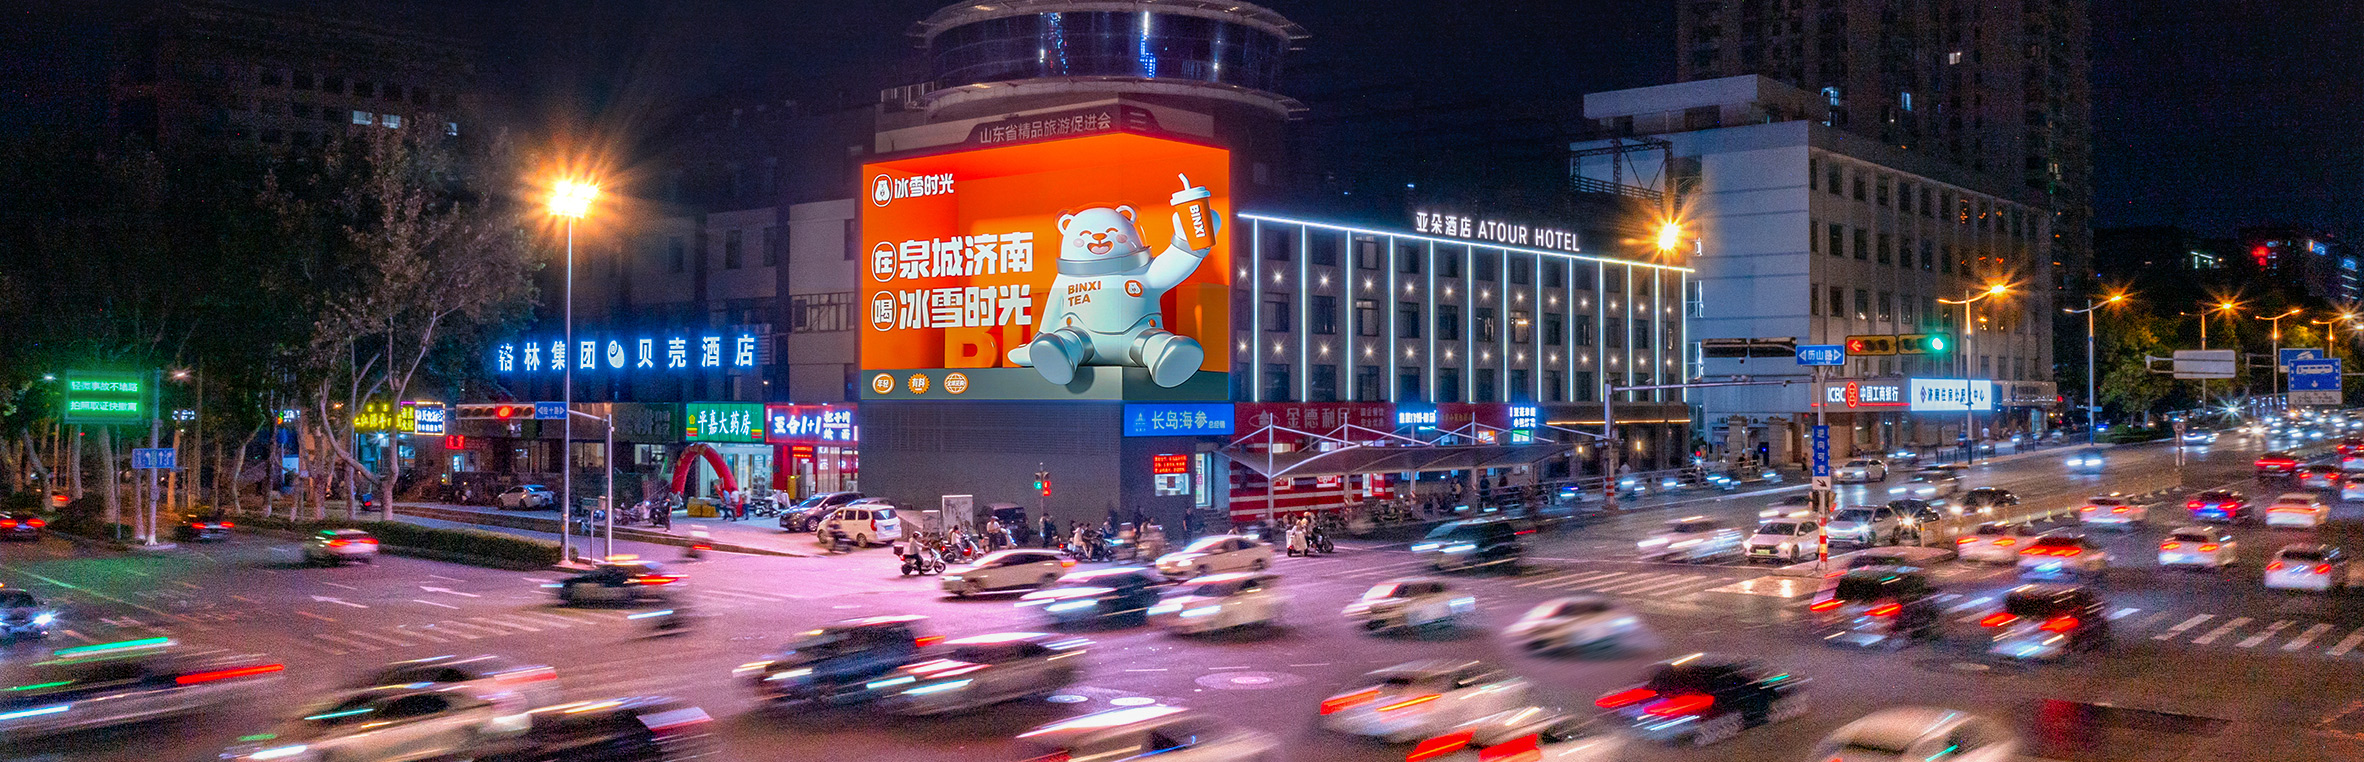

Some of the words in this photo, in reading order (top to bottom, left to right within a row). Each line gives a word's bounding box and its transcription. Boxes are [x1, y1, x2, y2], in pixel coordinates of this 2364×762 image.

[980, 112, 1111, 144] 山东省精品旅游促进会
[894, 173, 955, 199] 冰雪时光
[1189, 204, 1207, 238] BINXI
[1416, 211, 1471, 238] 亚朵酒店
[1477, 220, 1528, 245] ATOUR
[1535, 228, 1580, 252] HOTEL
[1067, 280, 1102, 295] BINXI
[1067, 293, 1091, 307] TEA
[498, 340, 596, 371] 格林集团
[637, 334, 755, 368] 贝壳酒店
[1807, 349, 1833, 361] 历山路
[1827, 386, 1846, 402] ICBC
[1860, 385, 1899, 402] 中国工商银行
[1927, 387, 1985, 402] 济南住房公积中心
[698, 410, 751, 436] 平嘉大药房
[1151, 410, 1208, 430] 长岛海参
